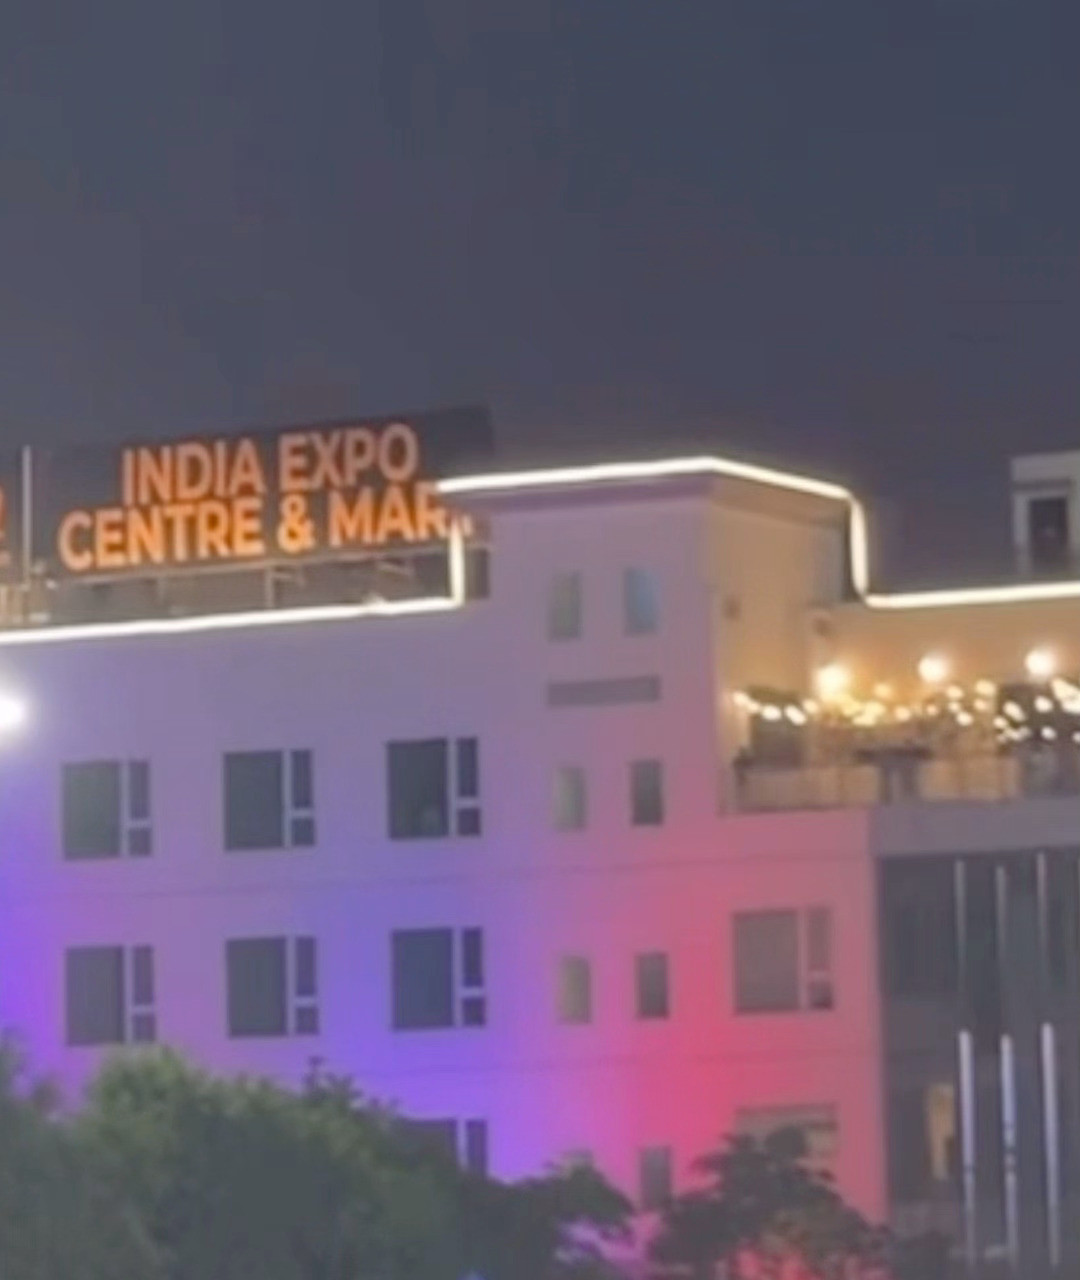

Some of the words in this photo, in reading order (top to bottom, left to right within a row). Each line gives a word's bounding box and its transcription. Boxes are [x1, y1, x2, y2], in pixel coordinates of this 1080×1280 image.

[123, 438, 266, 506] INDIA
[278, 423, 418, 492] EXPO
[57, 496, 266, 570] CENTRE
[277, 494, 318, 554] &
[328, 481, 473, 547] MAR
